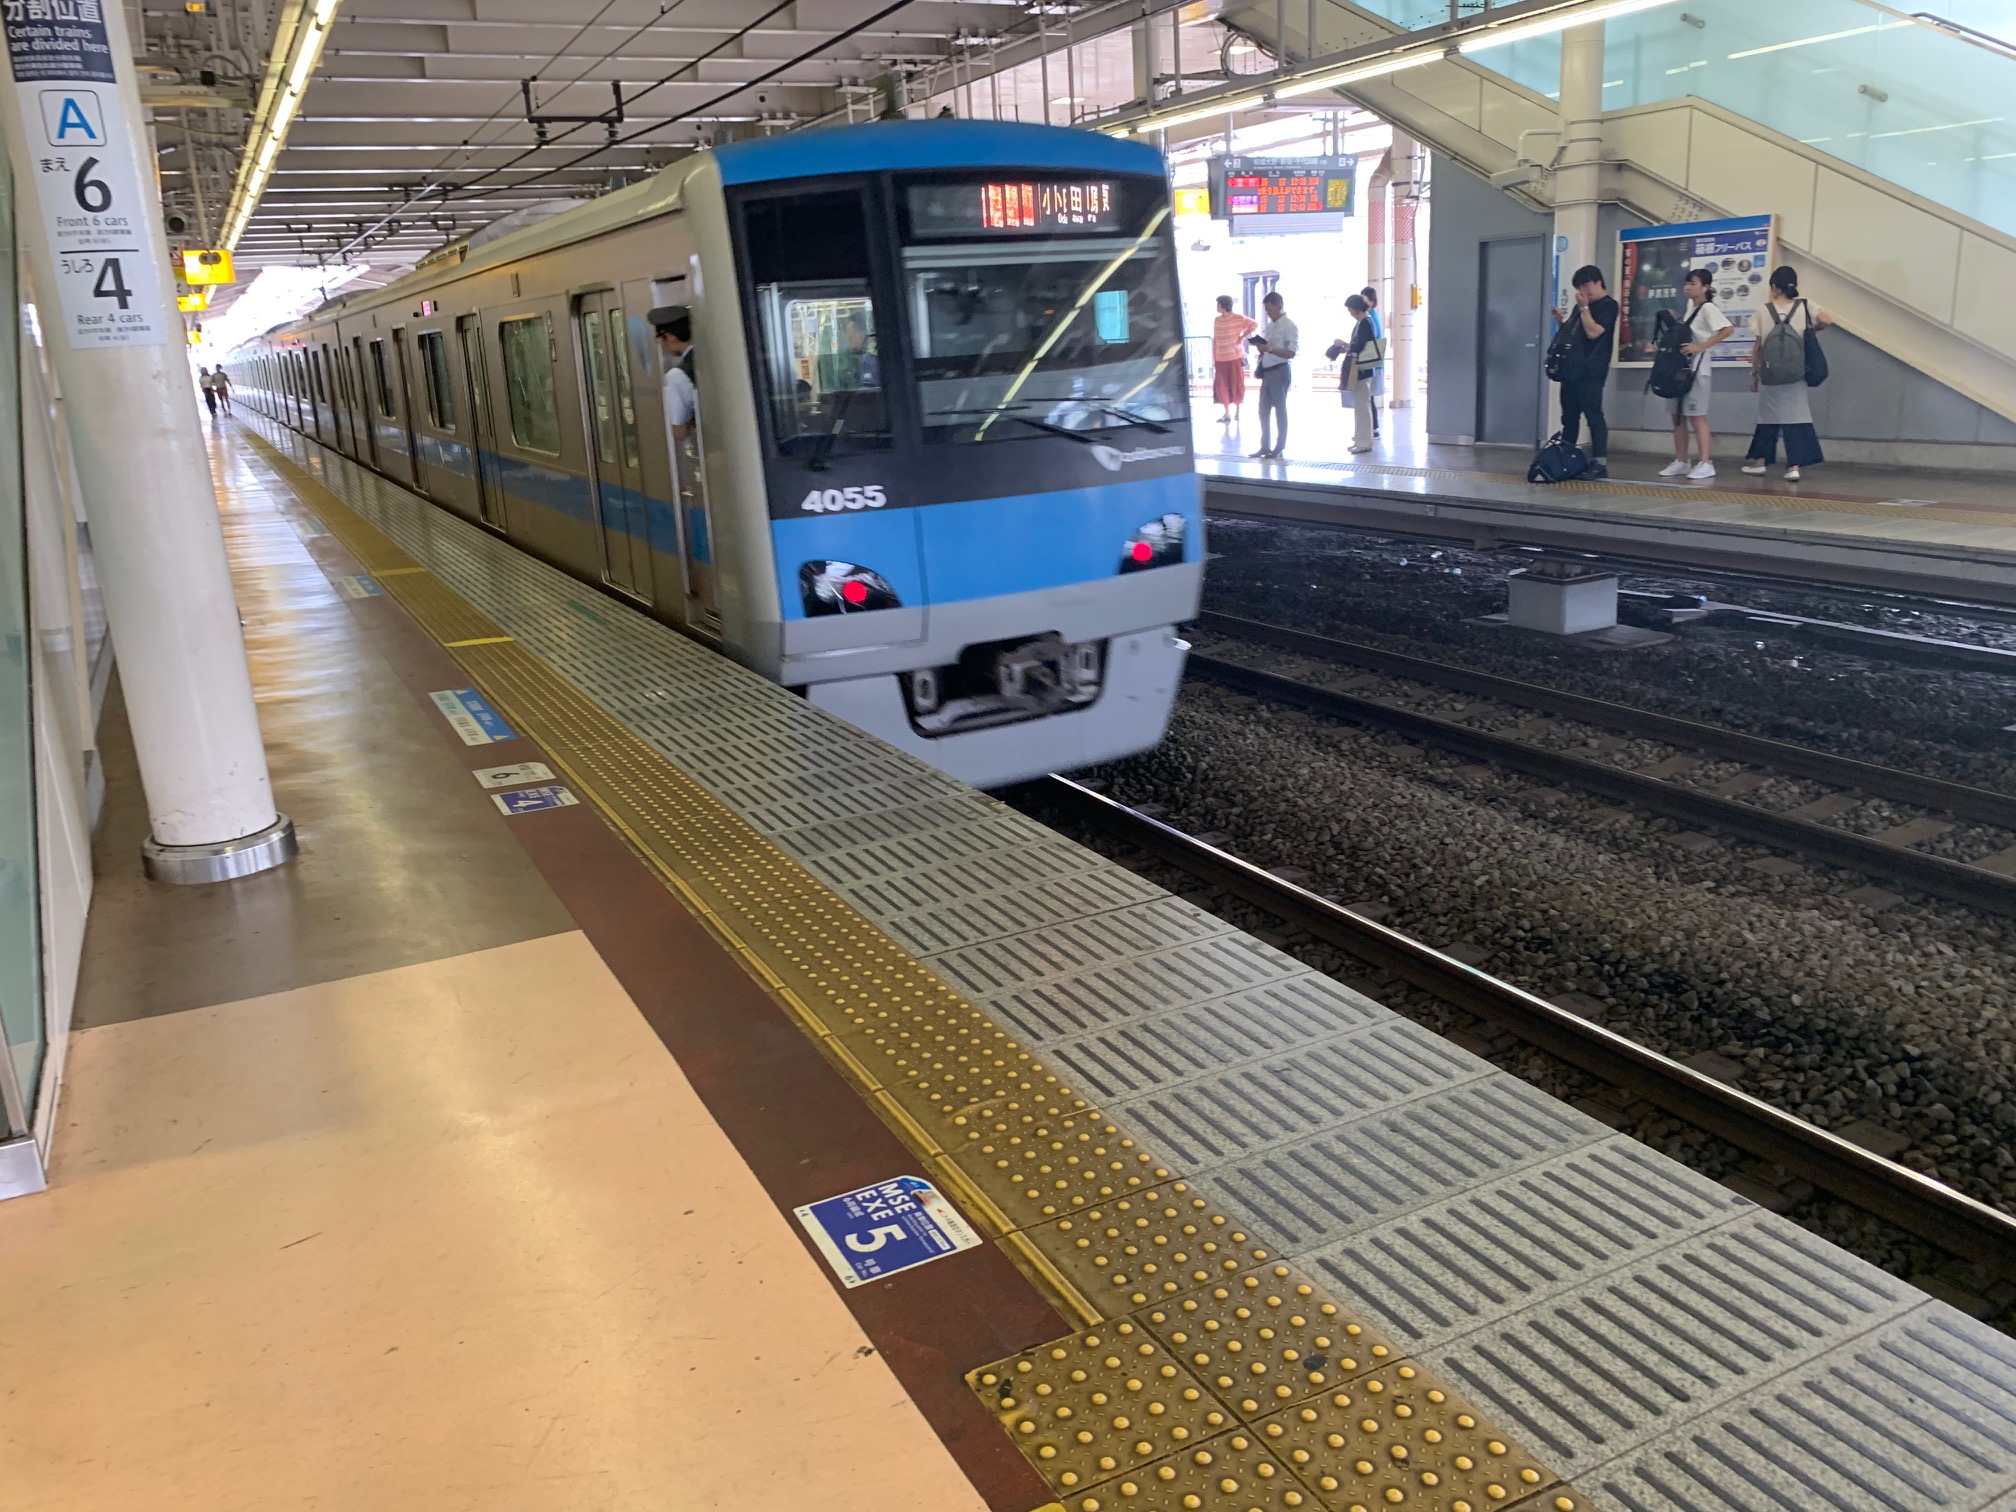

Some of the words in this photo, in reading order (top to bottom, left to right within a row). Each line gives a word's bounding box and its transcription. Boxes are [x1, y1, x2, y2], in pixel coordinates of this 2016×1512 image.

[3, 0, 101, 23] 分割位置
[7, 23, 52, 39] Certain
[53, 24, 93, 39] trains
[10, 41, 30, 52] are
[31, 37, 81, 51] divided
[81, 39, 109, 54] here
[57, 97, 97, 139] A
[40, 156, 71, 173] まえ
[74, 156, 112, 213] 6
[56, 216, 89, 227] Front
[92, 215, 101, 226] 6
[104, 217, 128, 227] cars
[61, 258, 95, 275] うしろ
[93, 257, 133, 310] 4
[77, 314, 103, 325] Rear
[107, 313, 116, 324] 4
[119, 313, 144, 324] cars
[801, 484, 887, 513] 4055
[512, 800, 544, 808] 4
[855, 1189, 895, 1222] EXE
[878, 1182, 918, 1214] MSE
[844, 1223, 908, 1253] 5
